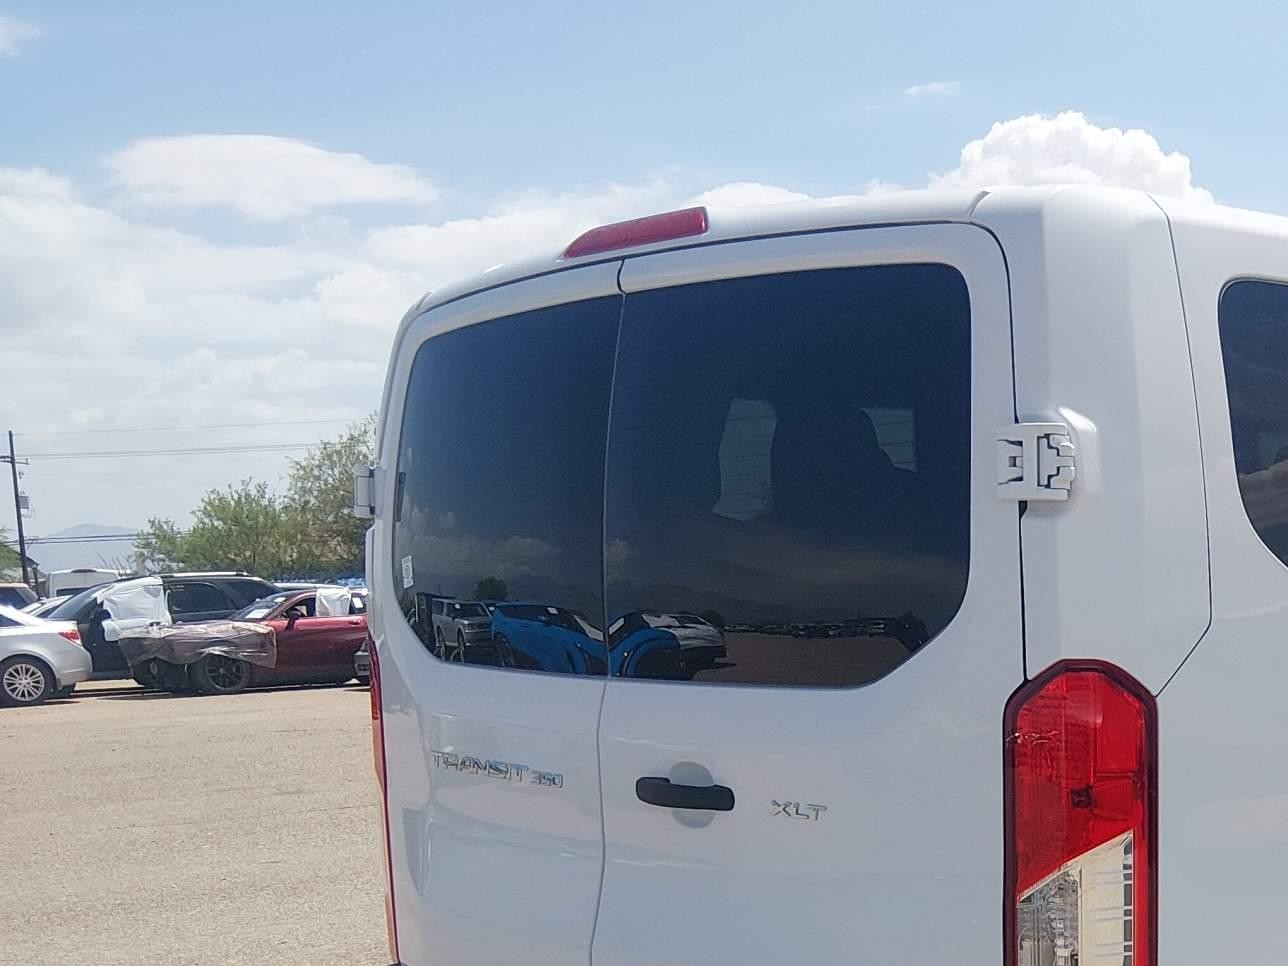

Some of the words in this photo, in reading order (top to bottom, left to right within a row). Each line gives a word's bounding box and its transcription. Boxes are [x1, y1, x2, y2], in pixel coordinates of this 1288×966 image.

[431, 750, 529, 783] TRANSIT
[530, 769, 564, 788] 350
[770, 799, 828, 821] XLT
